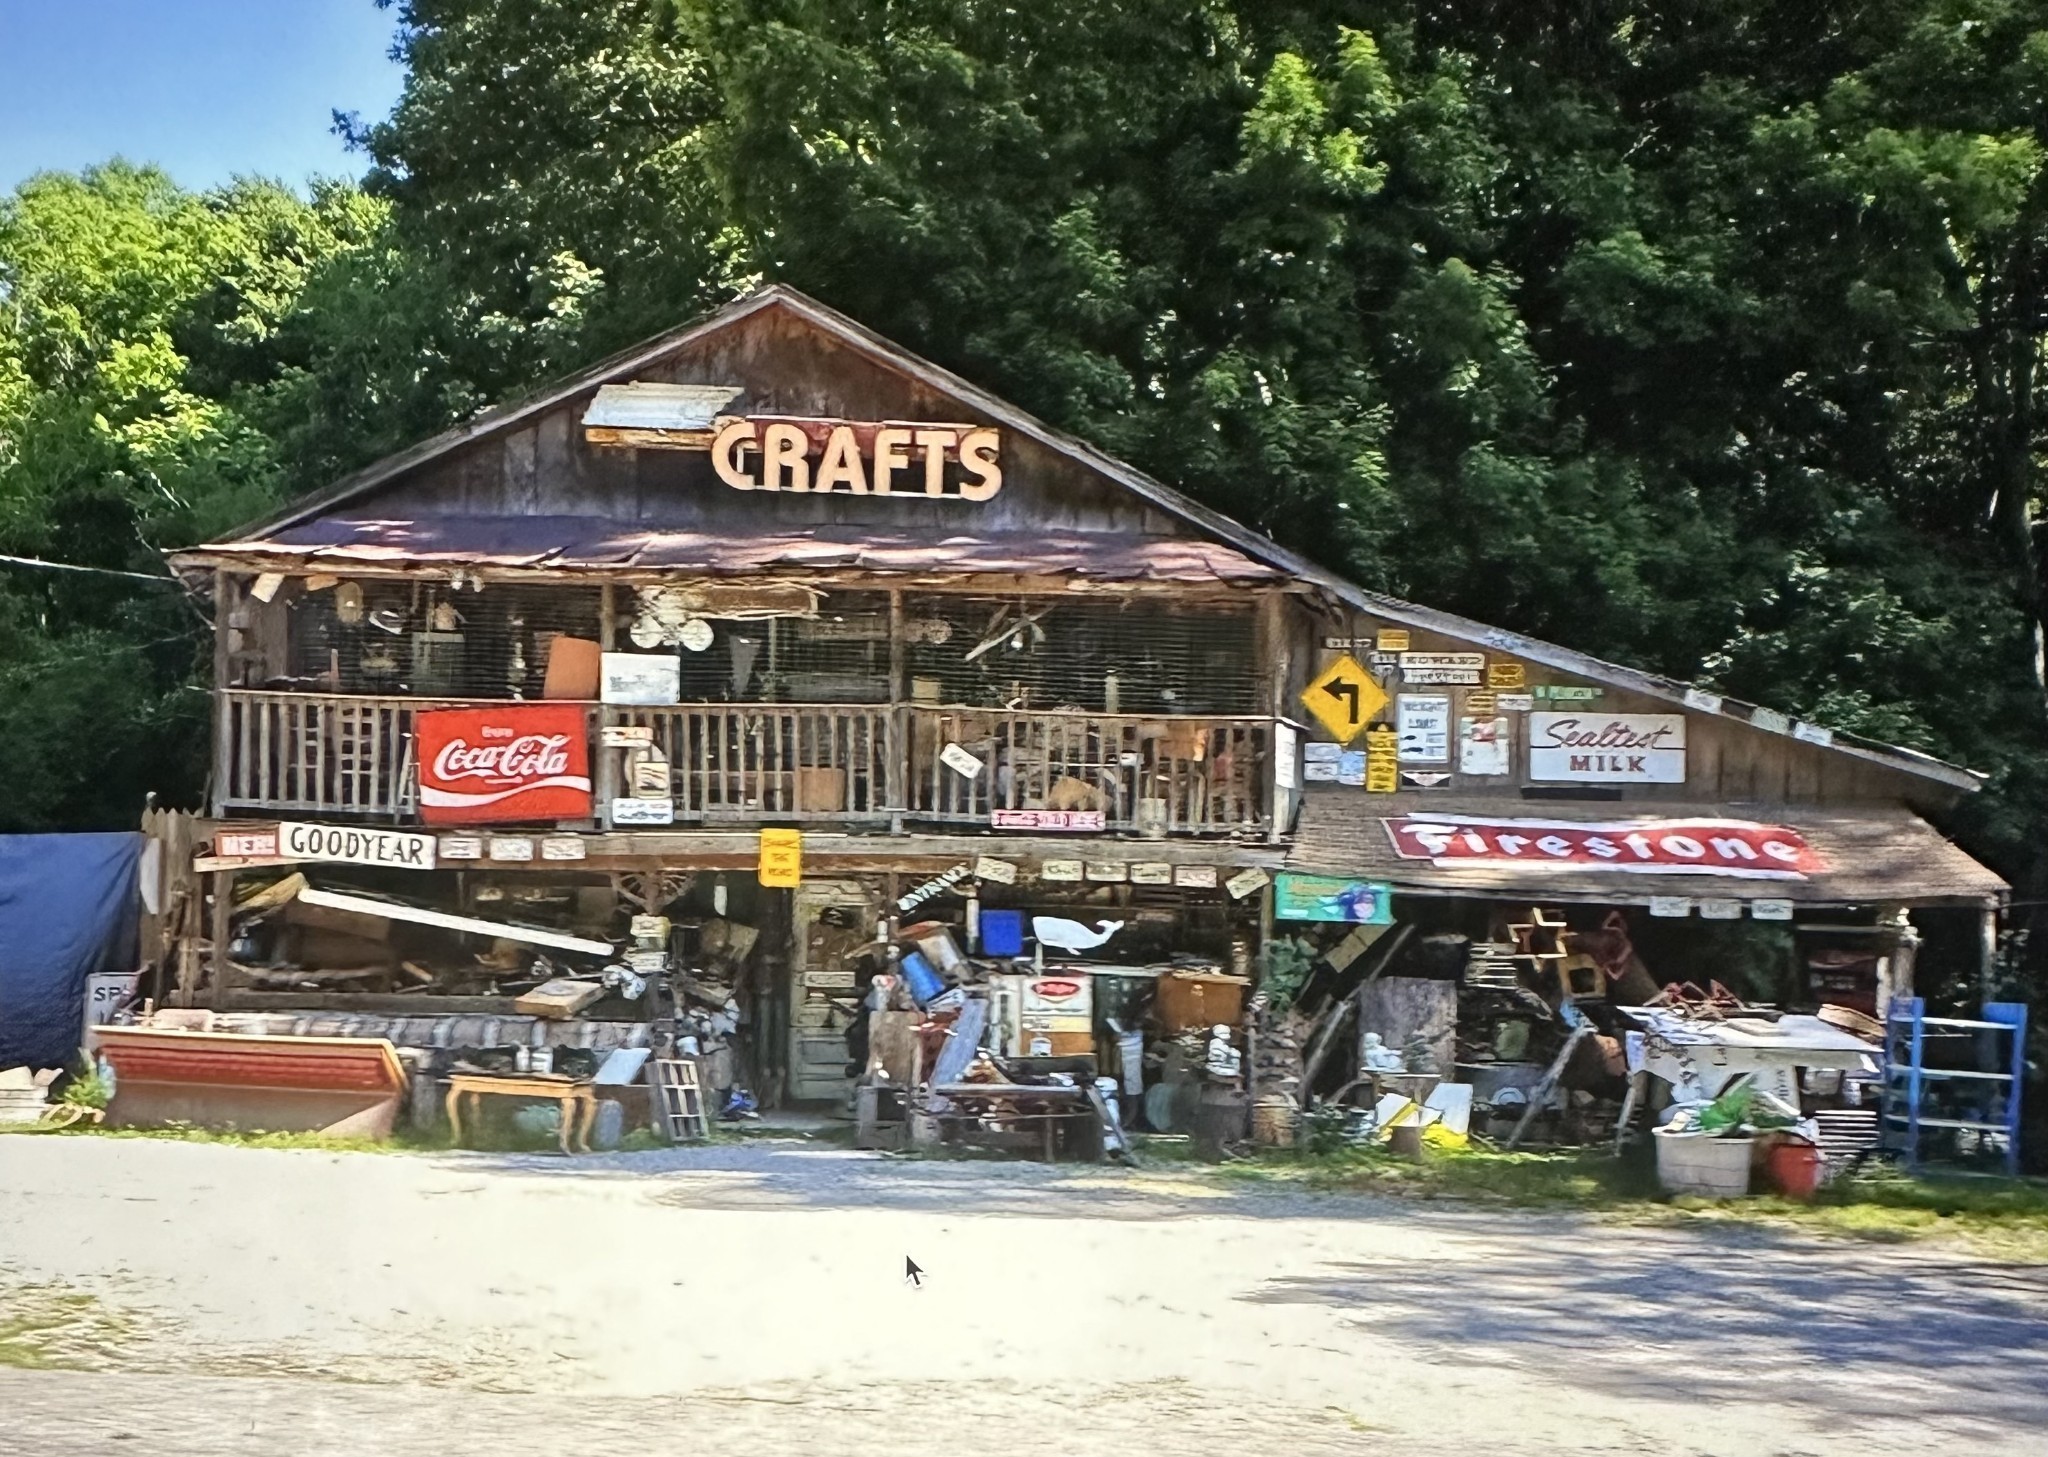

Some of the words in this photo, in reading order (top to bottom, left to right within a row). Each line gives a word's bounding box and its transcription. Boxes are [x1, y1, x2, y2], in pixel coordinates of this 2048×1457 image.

[711, 421, 1003, 502] CRAFTS
[1545, 717, 1674, 748] Sealtest
[432, 734, 573, 781] Coca-Cola
[1569, 755, 1647, 773] MILK
[289, 826, 425, 866] GOODYEAR
[1400, 823, 1799, 862] Firestone
